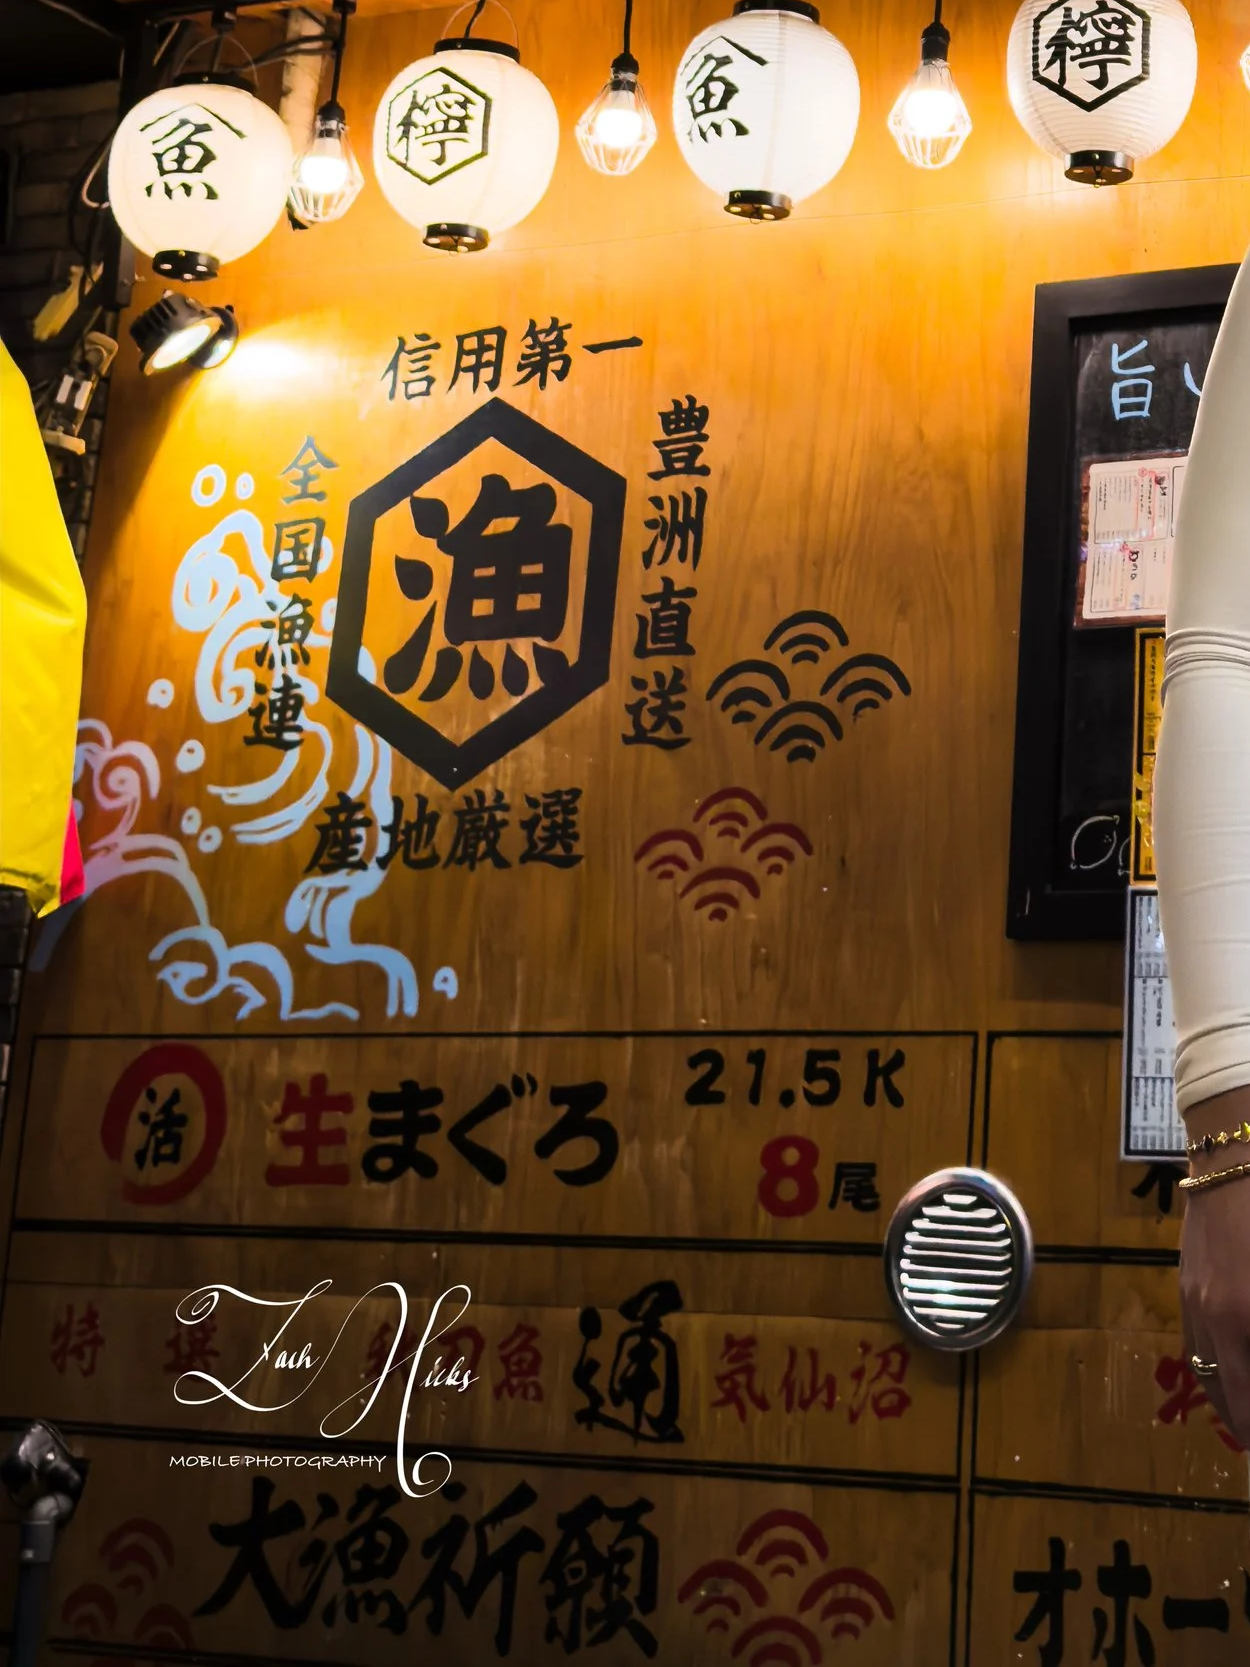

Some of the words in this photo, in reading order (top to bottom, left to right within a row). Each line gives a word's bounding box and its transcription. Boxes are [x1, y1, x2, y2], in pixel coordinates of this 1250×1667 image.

[684, 54, 750, 146] 魚
[145, 118, 220, 201] 魚
[380, 316, 645, 402] 信用第一
[243, 435, 340, 752] 全国漁連
[381, 472, 574, 703] 漁
[621, 394, 711, 751] 豊洲直送
[304, 787, 586, 877] 産地厳選
[133, 1087, 190, 1172] 活
[265, 1073, 620, 1189] 生まぐろ
[756, 1135, 881, 1219] 8尾
[571, 1280, 686, 1444] 通
[708, 1334, 913, 1425] 気仙沼
[191, 1476, 660, 1659] 大漁祈願
